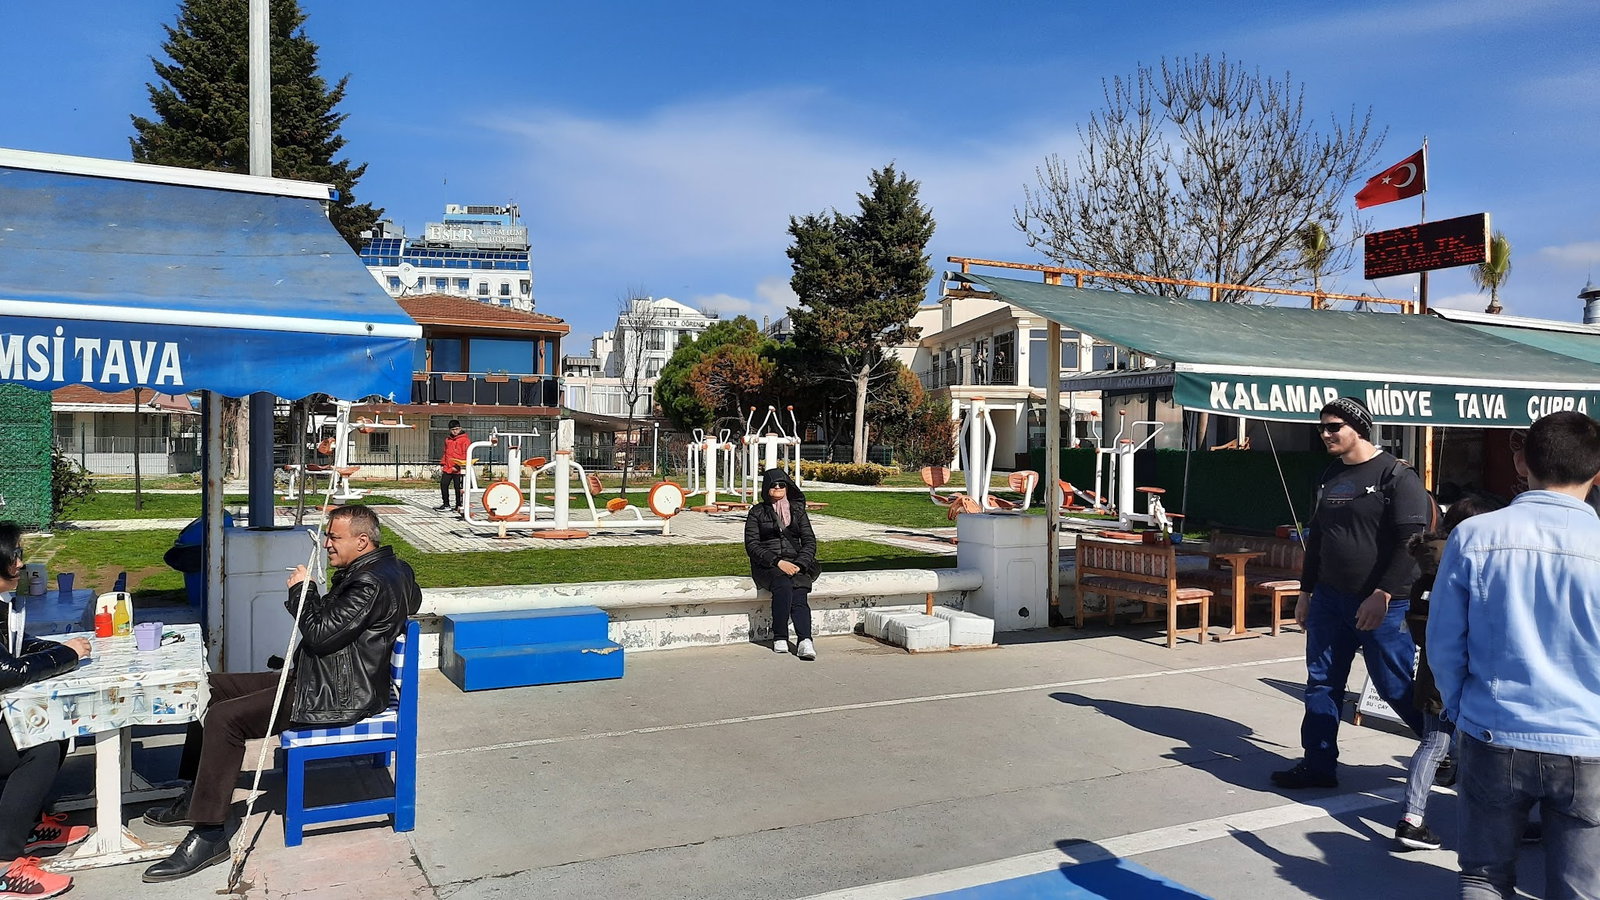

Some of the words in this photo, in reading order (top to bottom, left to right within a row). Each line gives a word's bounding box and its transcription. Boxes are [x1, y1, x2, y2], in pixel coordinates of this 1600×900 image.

[74, 337, 184, 386] TAVA
[1365, 383, 1433, 417] MİDYE
[1455, 392, 1507, 419] TAVA
